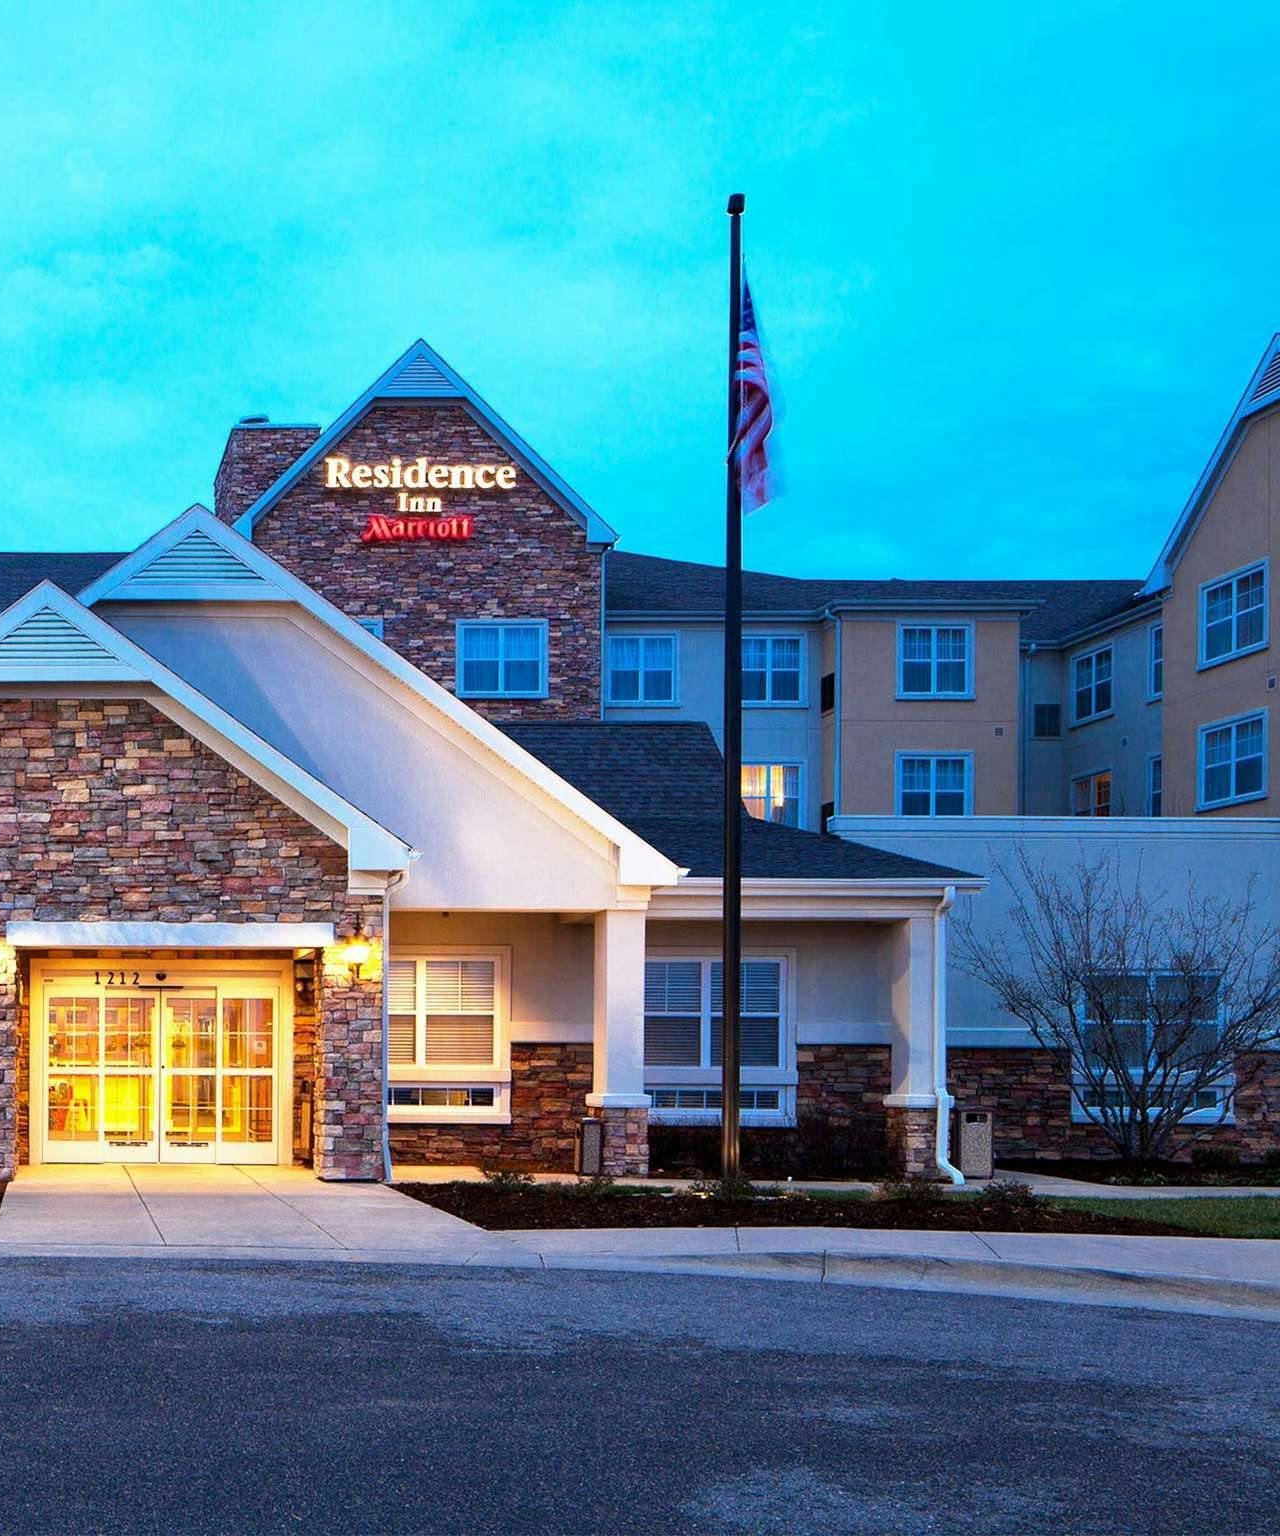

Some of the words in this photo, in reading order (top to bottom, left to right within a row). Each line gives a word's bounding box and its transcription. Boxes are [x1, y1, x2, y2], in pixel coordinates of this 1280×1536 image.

[325, 457, 517, 489] Residence
[398, 491, 442, 512] Inn
[362, 515, 473, 541] Marriott
[94, 971, 140, 985] 1212
